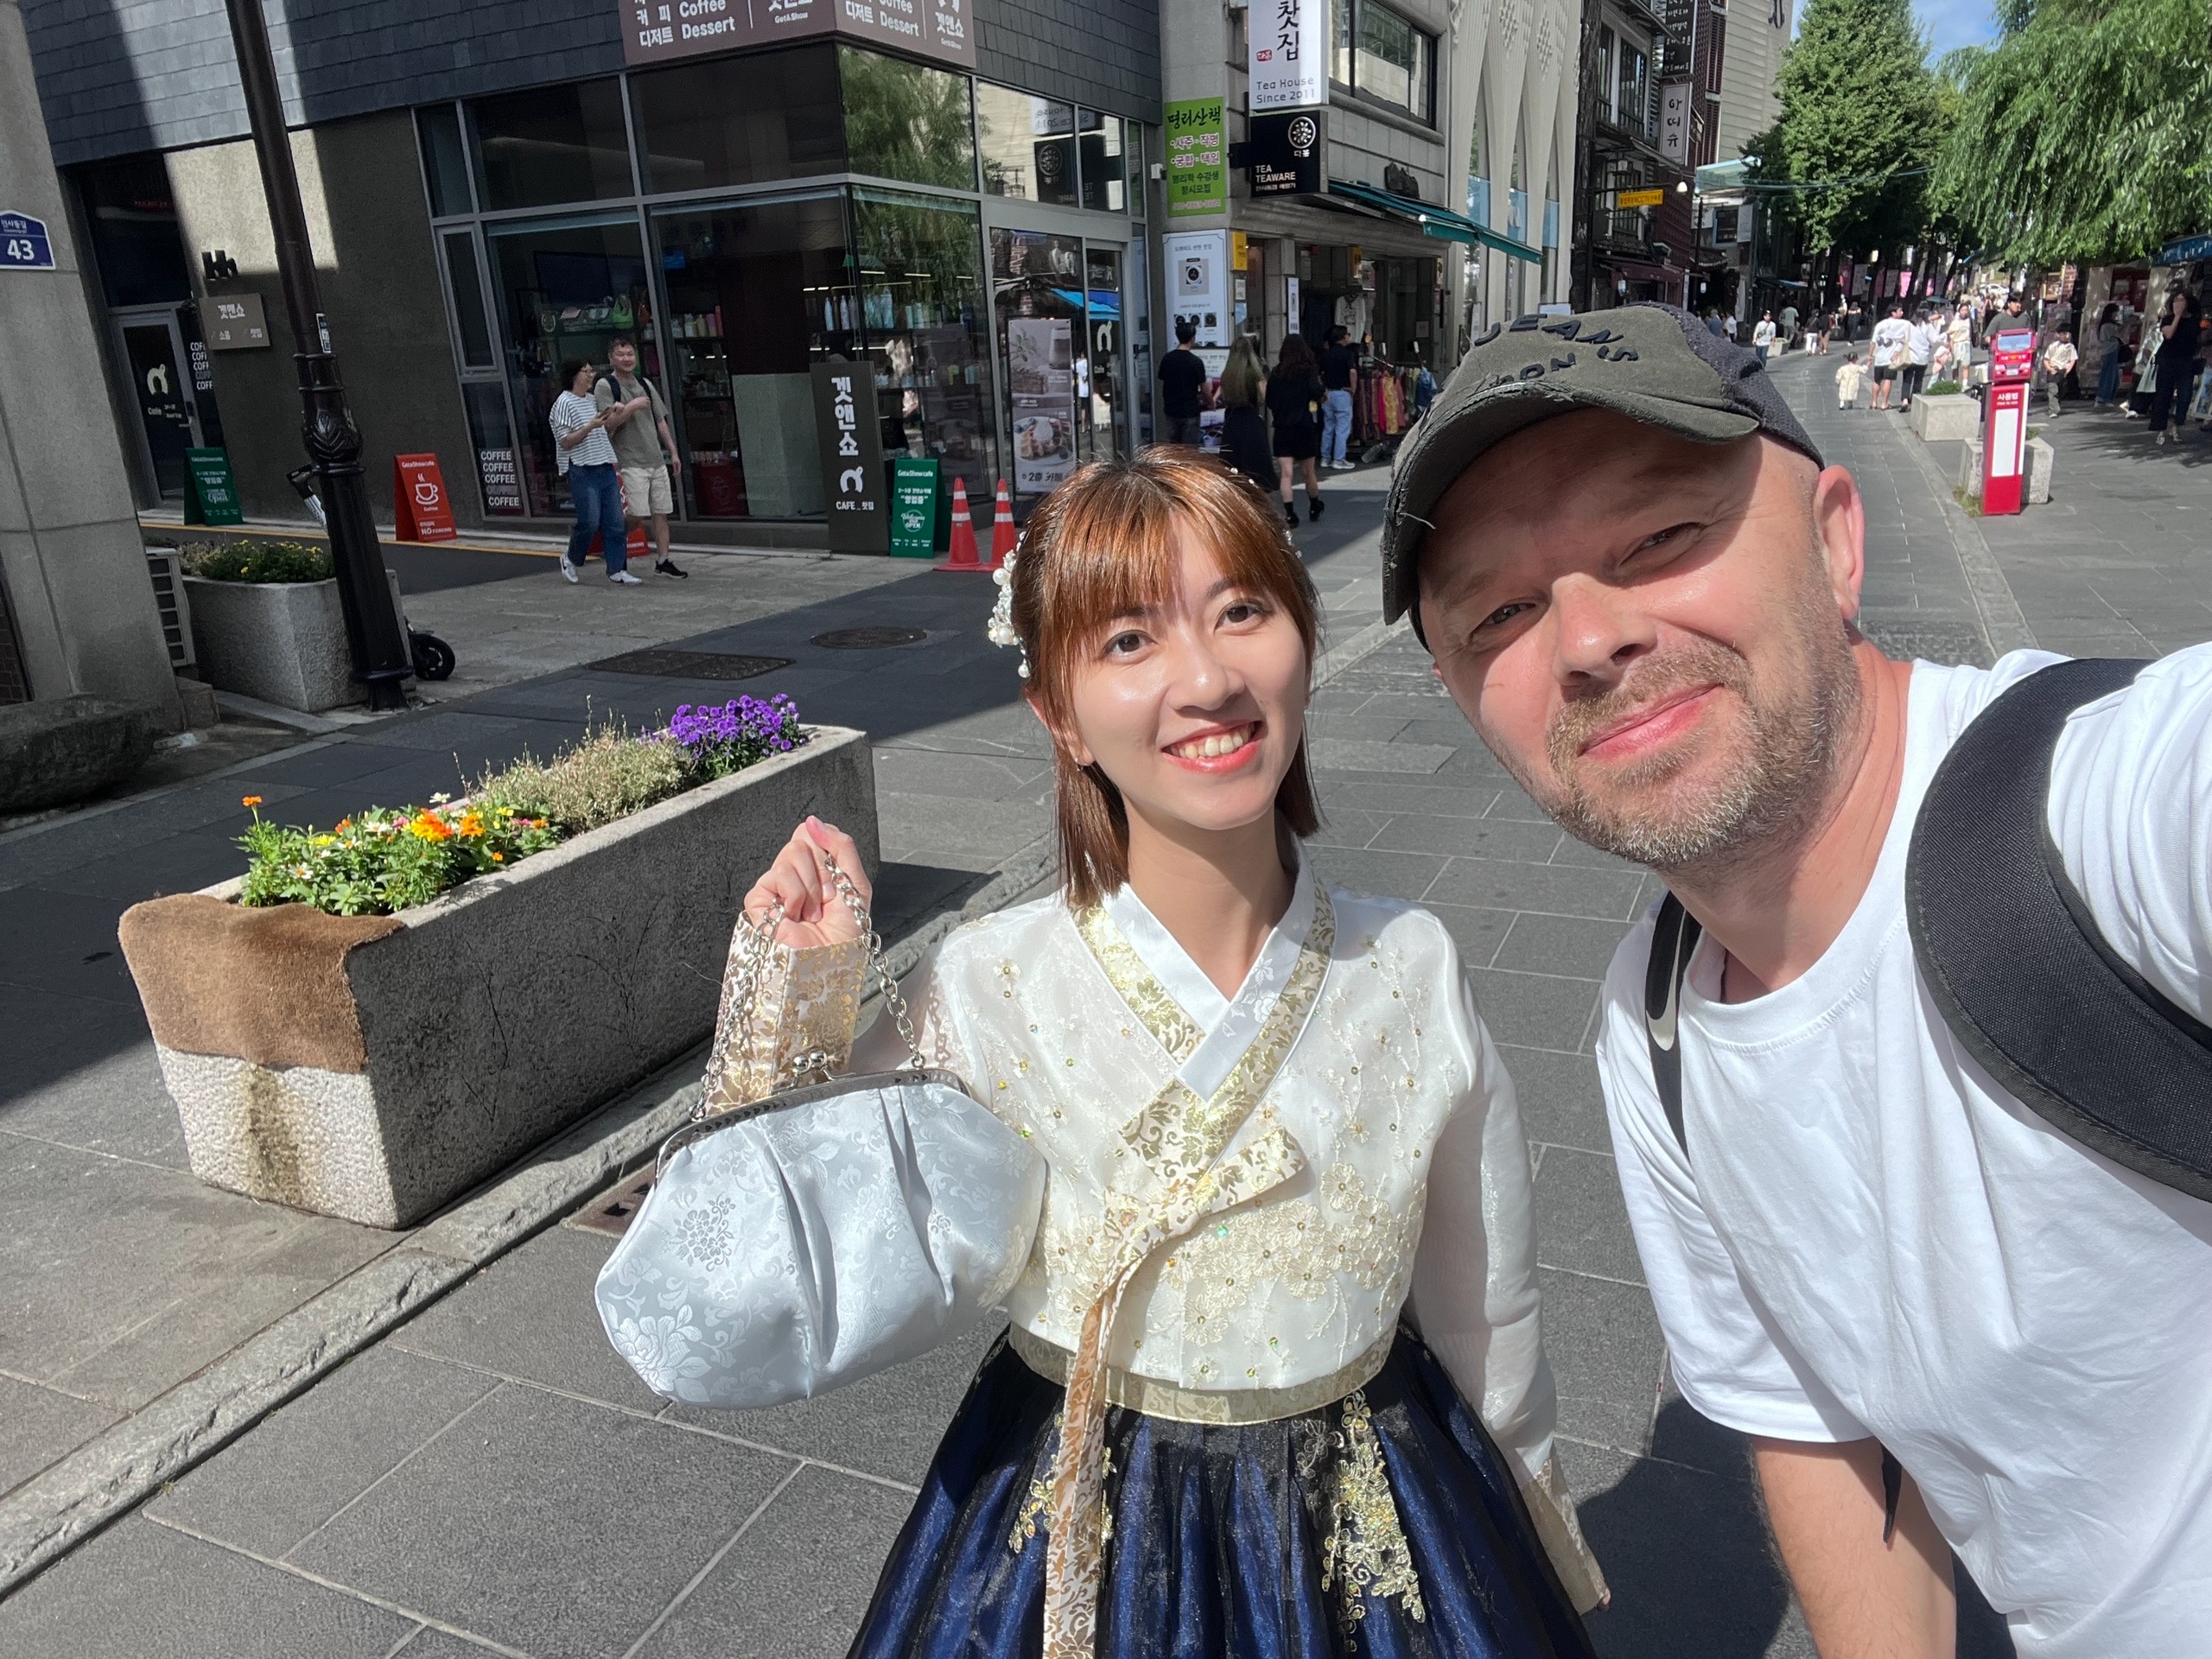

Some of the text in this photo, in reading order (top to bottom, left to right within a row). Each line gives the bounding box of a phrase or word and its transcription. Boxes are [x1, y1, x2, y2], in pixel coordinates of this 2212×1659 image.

[636, 0, 726, 26] 커 피 Coffee
[774, 11, 809, 24] Get&Show
[845, 1, 919, 37] 디저트 Dessert
[639, 16, 735, 47] 디저트 Dessert
[935, 11, 964, 38] 겟앤쇼
[1277, 0, 1300, 61] 찻집
[1256, 78, 1314, 90] Tea House
[1256, 89, 1315, 104] Since 2011
[1167, 105, 1221, 130] 명리산책
[1255, 164, 1272, 174] TEA
[1255, 171, 1296, 183] TEAWARE
[7, 238, 35, 260] 43
[218, 303, 245, 320] 겟앤쇼
[830, 376, 859, 456] 겟앤쇼
[480, 450, 512, 461] COFFEE
[482, 462, 513, 472] COFFEE
[485, 474, 516, 484] COFFEE
[488, 496, 519, 506] COFFEE
[836, 501, 856, 510] CAFE
